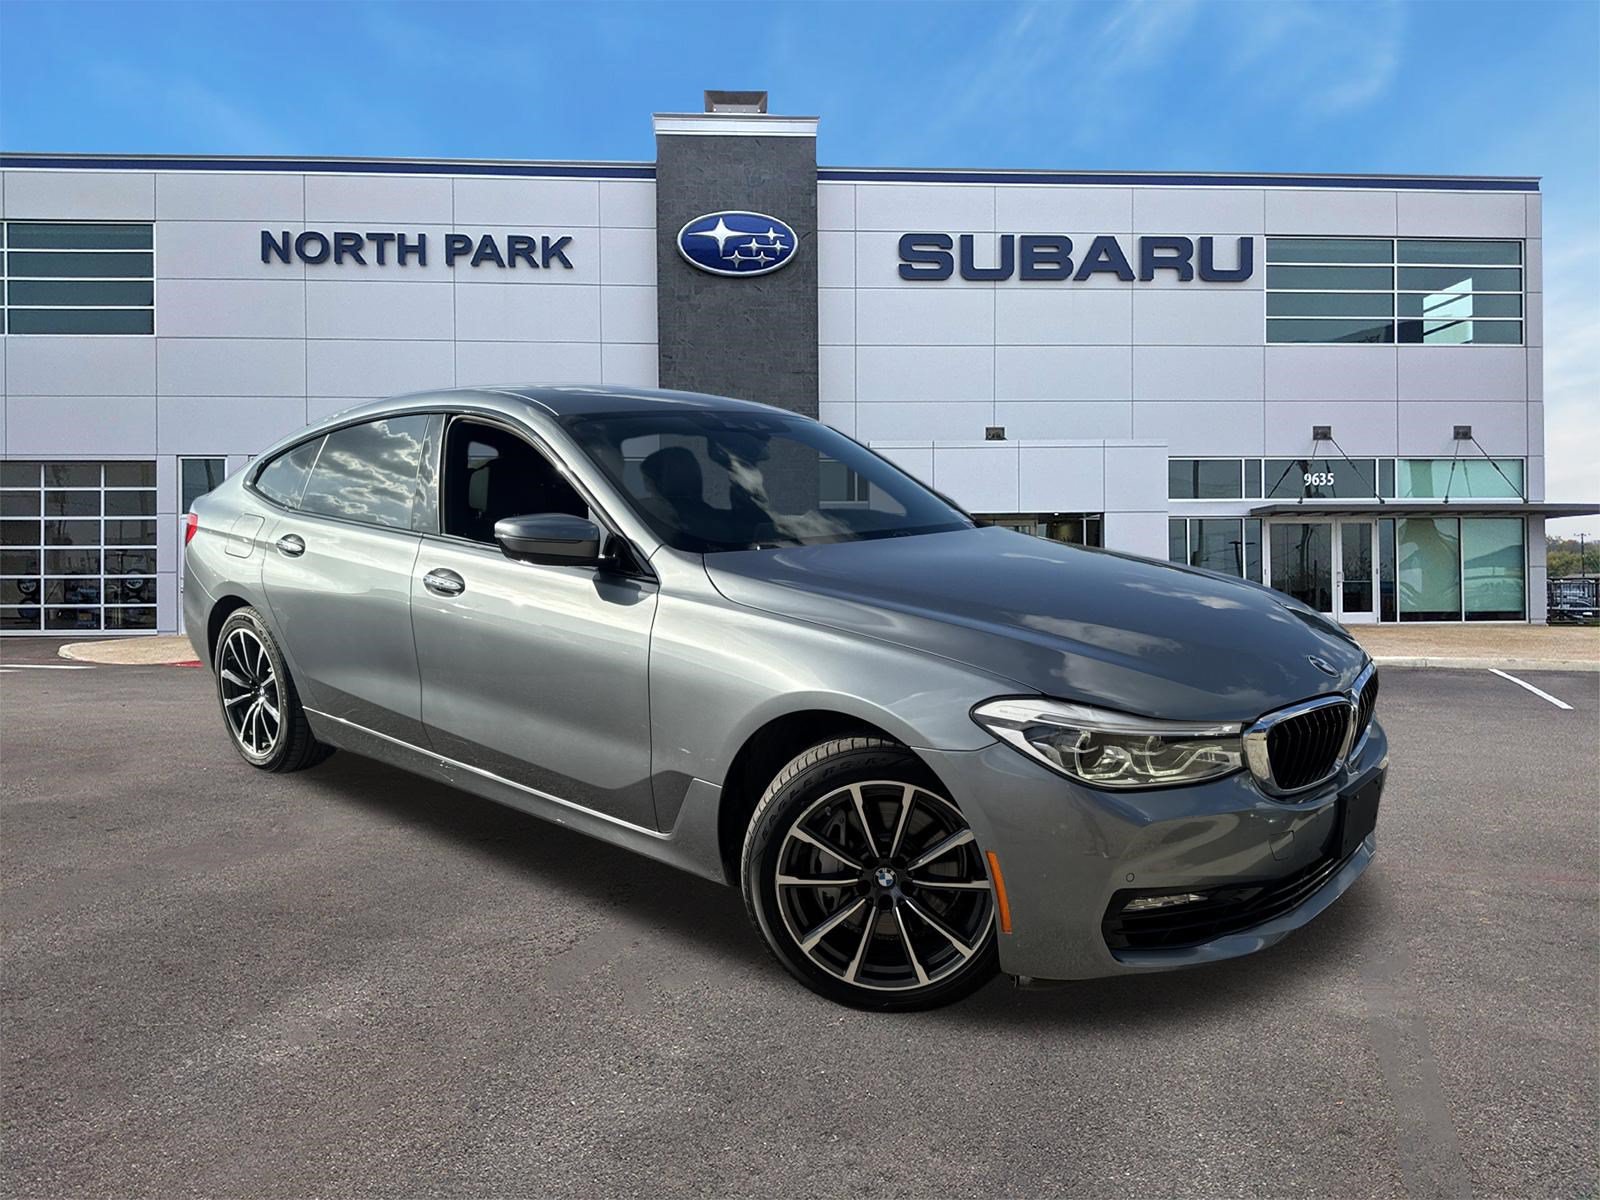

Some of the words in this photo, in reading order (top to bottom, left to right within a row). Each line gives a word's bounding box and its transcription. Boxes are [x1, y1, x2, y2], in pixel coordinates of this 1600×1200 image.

[260, 230, 427, 267] NORTH
[444, 233, 574, 269] PARK
[898, 233, 1254, 283] SUBARU
[1303, 472, 1334, 486] 9635
